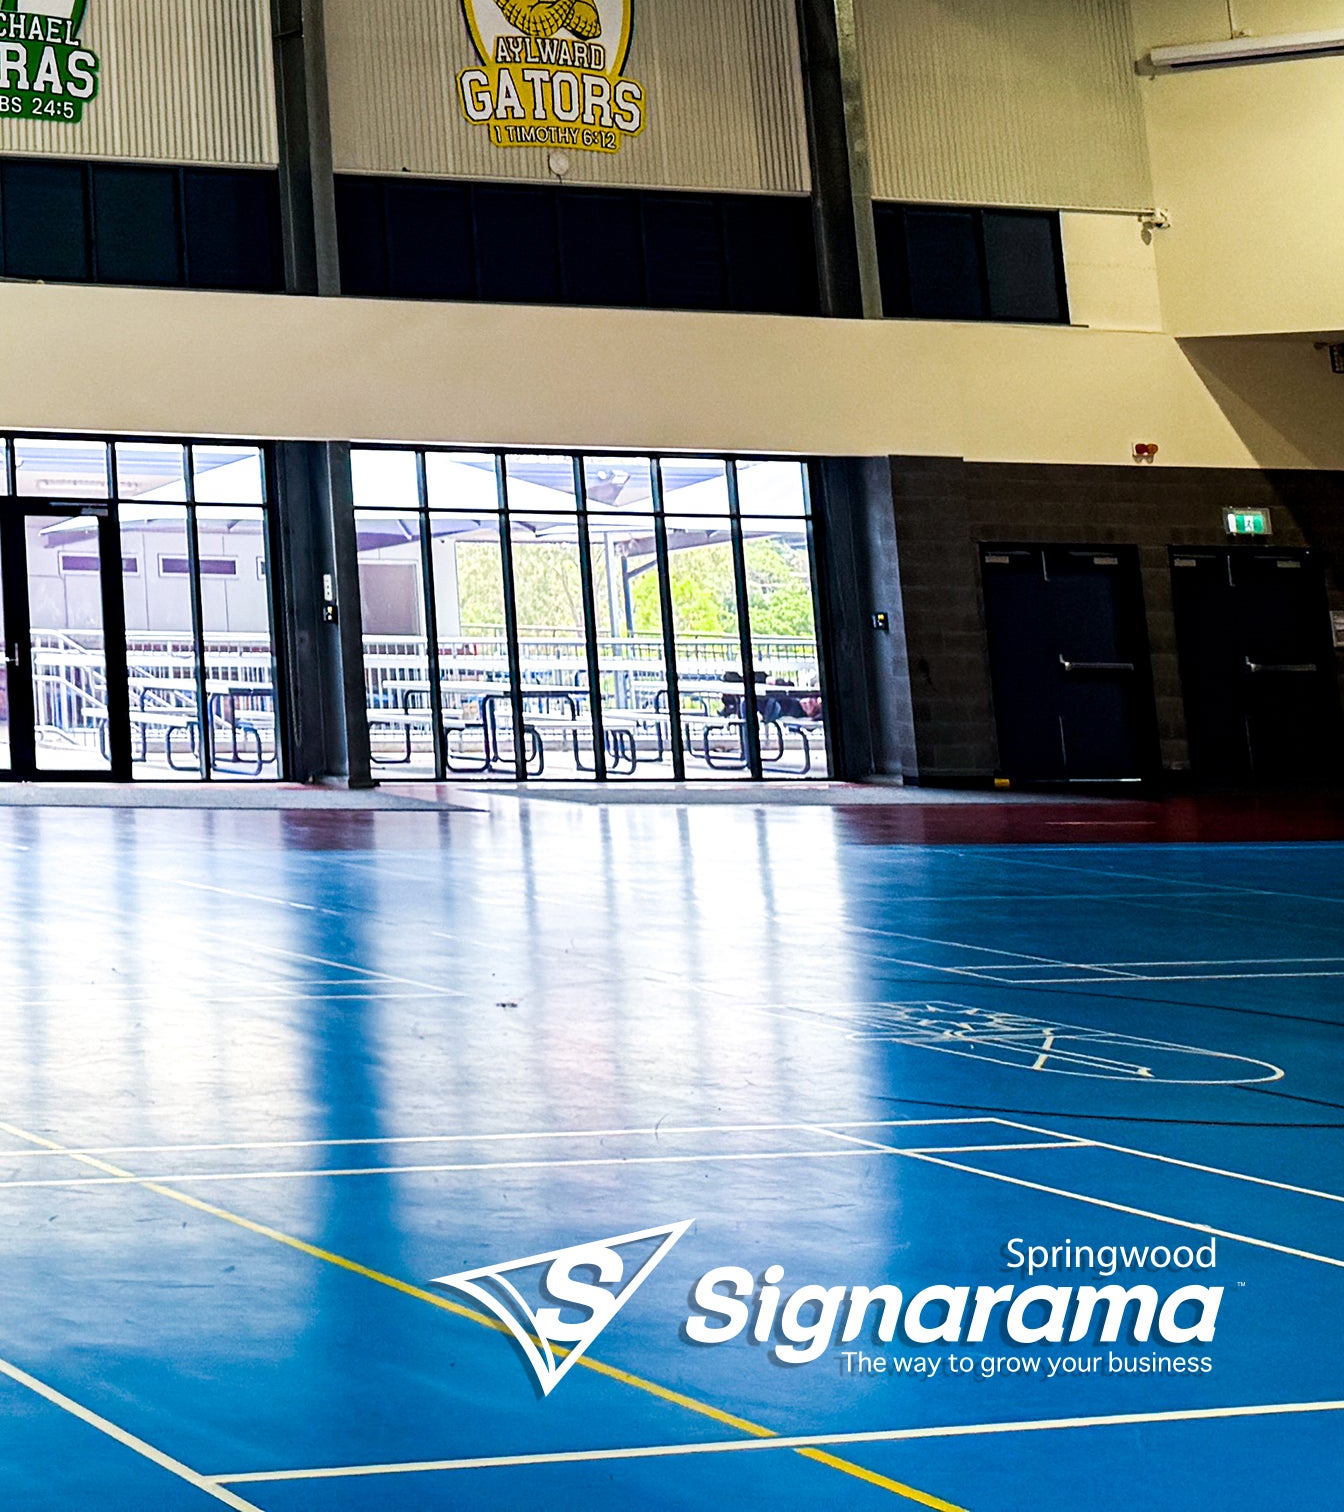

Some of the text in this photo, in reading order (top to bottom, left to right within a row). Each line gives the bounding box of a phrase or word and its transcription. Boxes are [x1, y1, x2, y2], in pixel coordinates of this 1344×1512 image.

[496, 37, 605, 70] AYLWARD
[32, 98, 74, 118] 24:5
[461, 68, 642, 132] GATORS
[495, 126, 616, 148] 1 TIMOTHY 6:12
